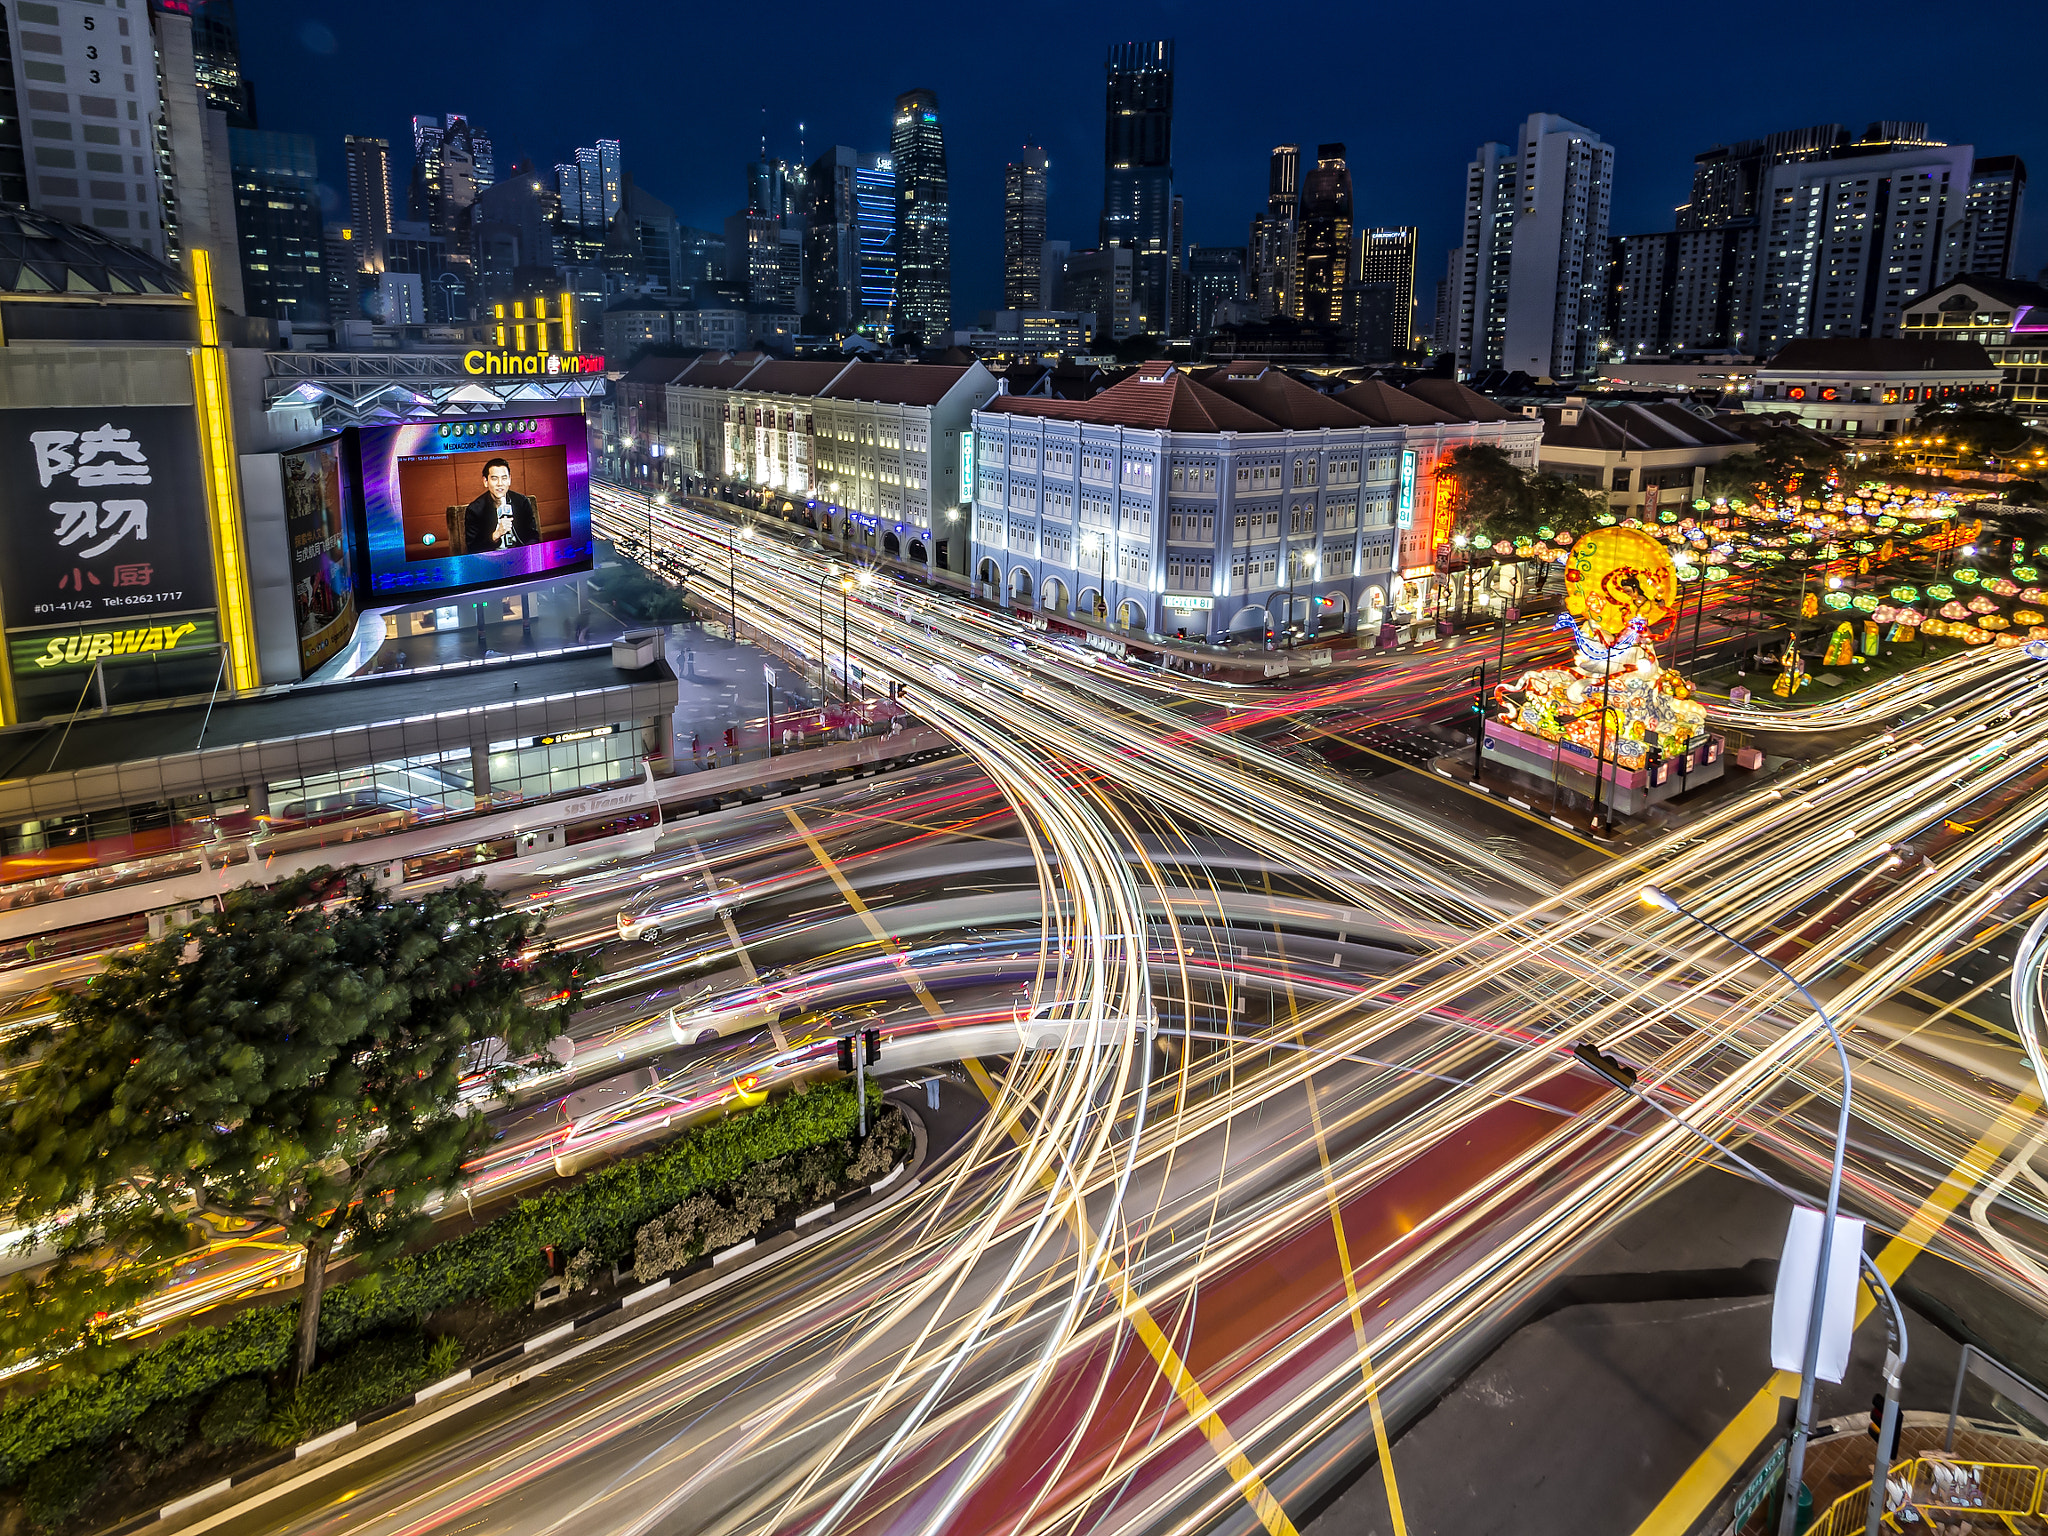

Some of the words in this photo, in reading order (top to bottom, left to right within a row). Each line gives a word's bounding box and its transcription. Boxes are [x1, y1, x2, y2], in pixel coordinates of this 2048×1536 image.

[83, 16, 101, 84] 533
[1403, 455, 1413, 508] HOTEL
[1400, 511, 1410, 522] 81
[34, 599, 92, 613] #01-41/42
[102, 596, 124, 607] Tel:
[125, 594, 154, 606] 6262
[155, 591, 183, 603] 1717
[34, 622, 197, 668] SUBWAY
[587, 793, 638, 811] Transit
